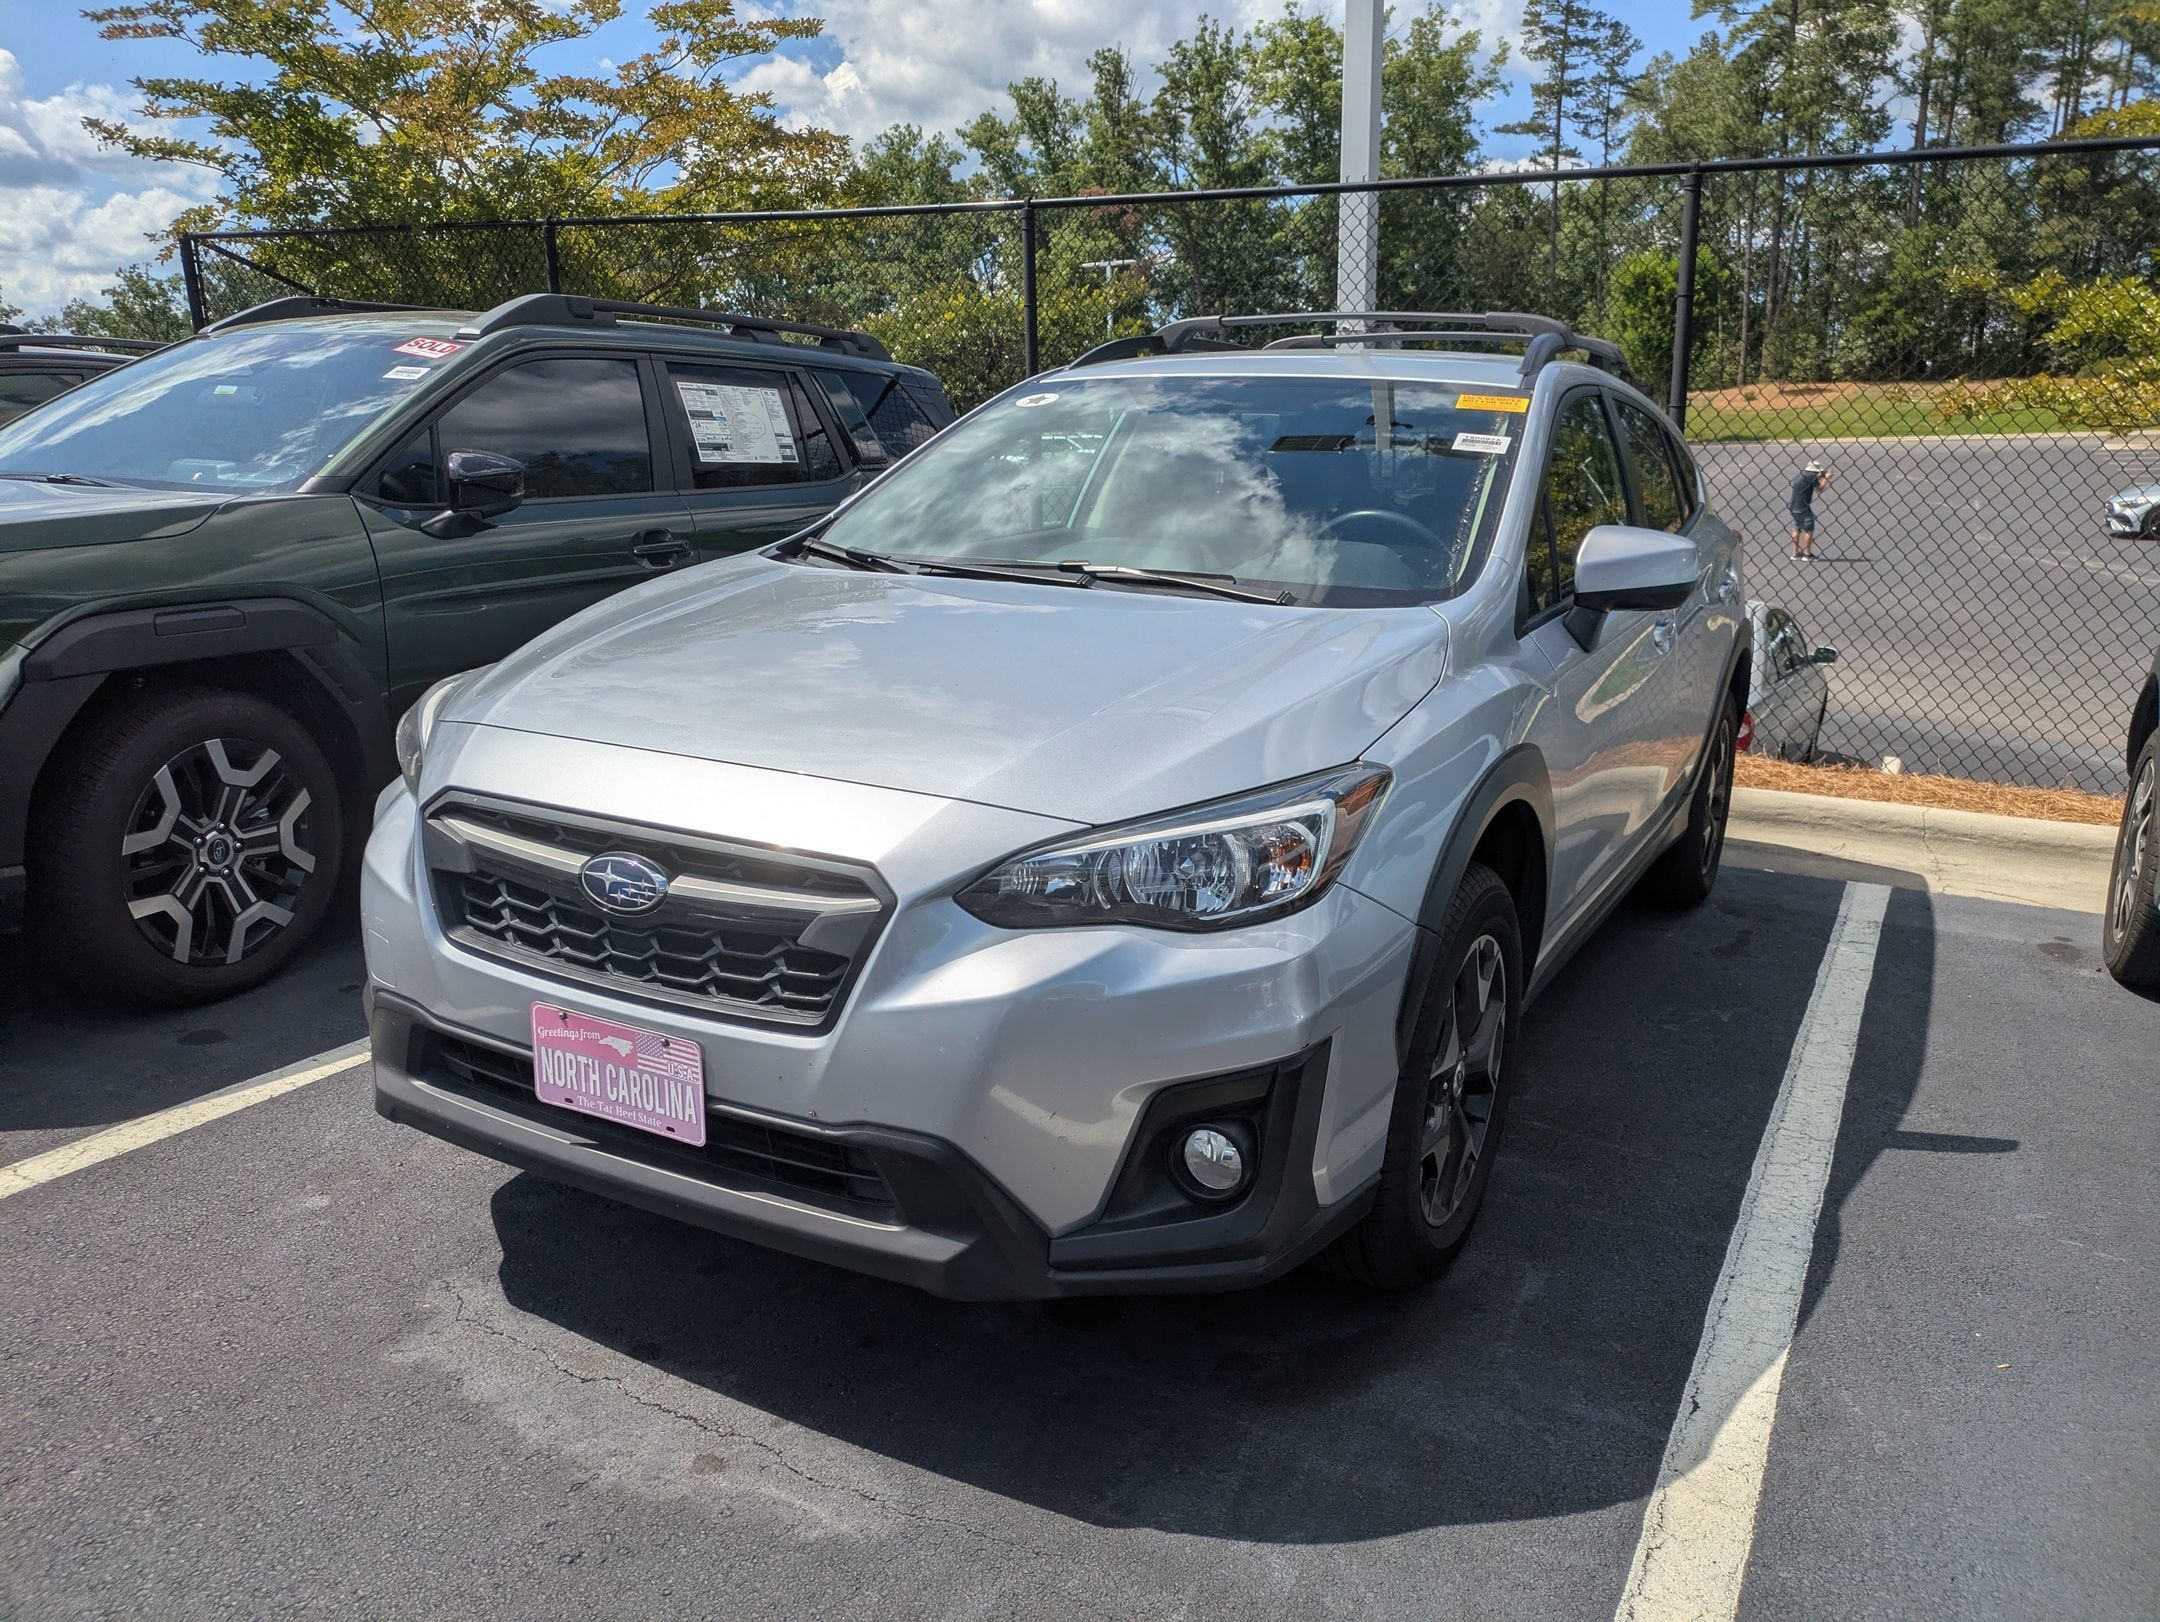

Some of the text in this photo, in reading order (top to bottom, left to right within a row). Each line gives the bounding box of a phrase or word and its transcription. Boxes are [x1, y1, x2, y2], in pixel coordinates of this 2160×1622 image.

[407, 340, 457, 354] SOLD
[538, 1026, 600, 1040] Greetings from
[667, 1062, 697, 1082] U.S.A.
[540, 1046, 697, 1125] NORTH CAROLINA
[577, 1095, 662, 1127] The Tar Heel State
